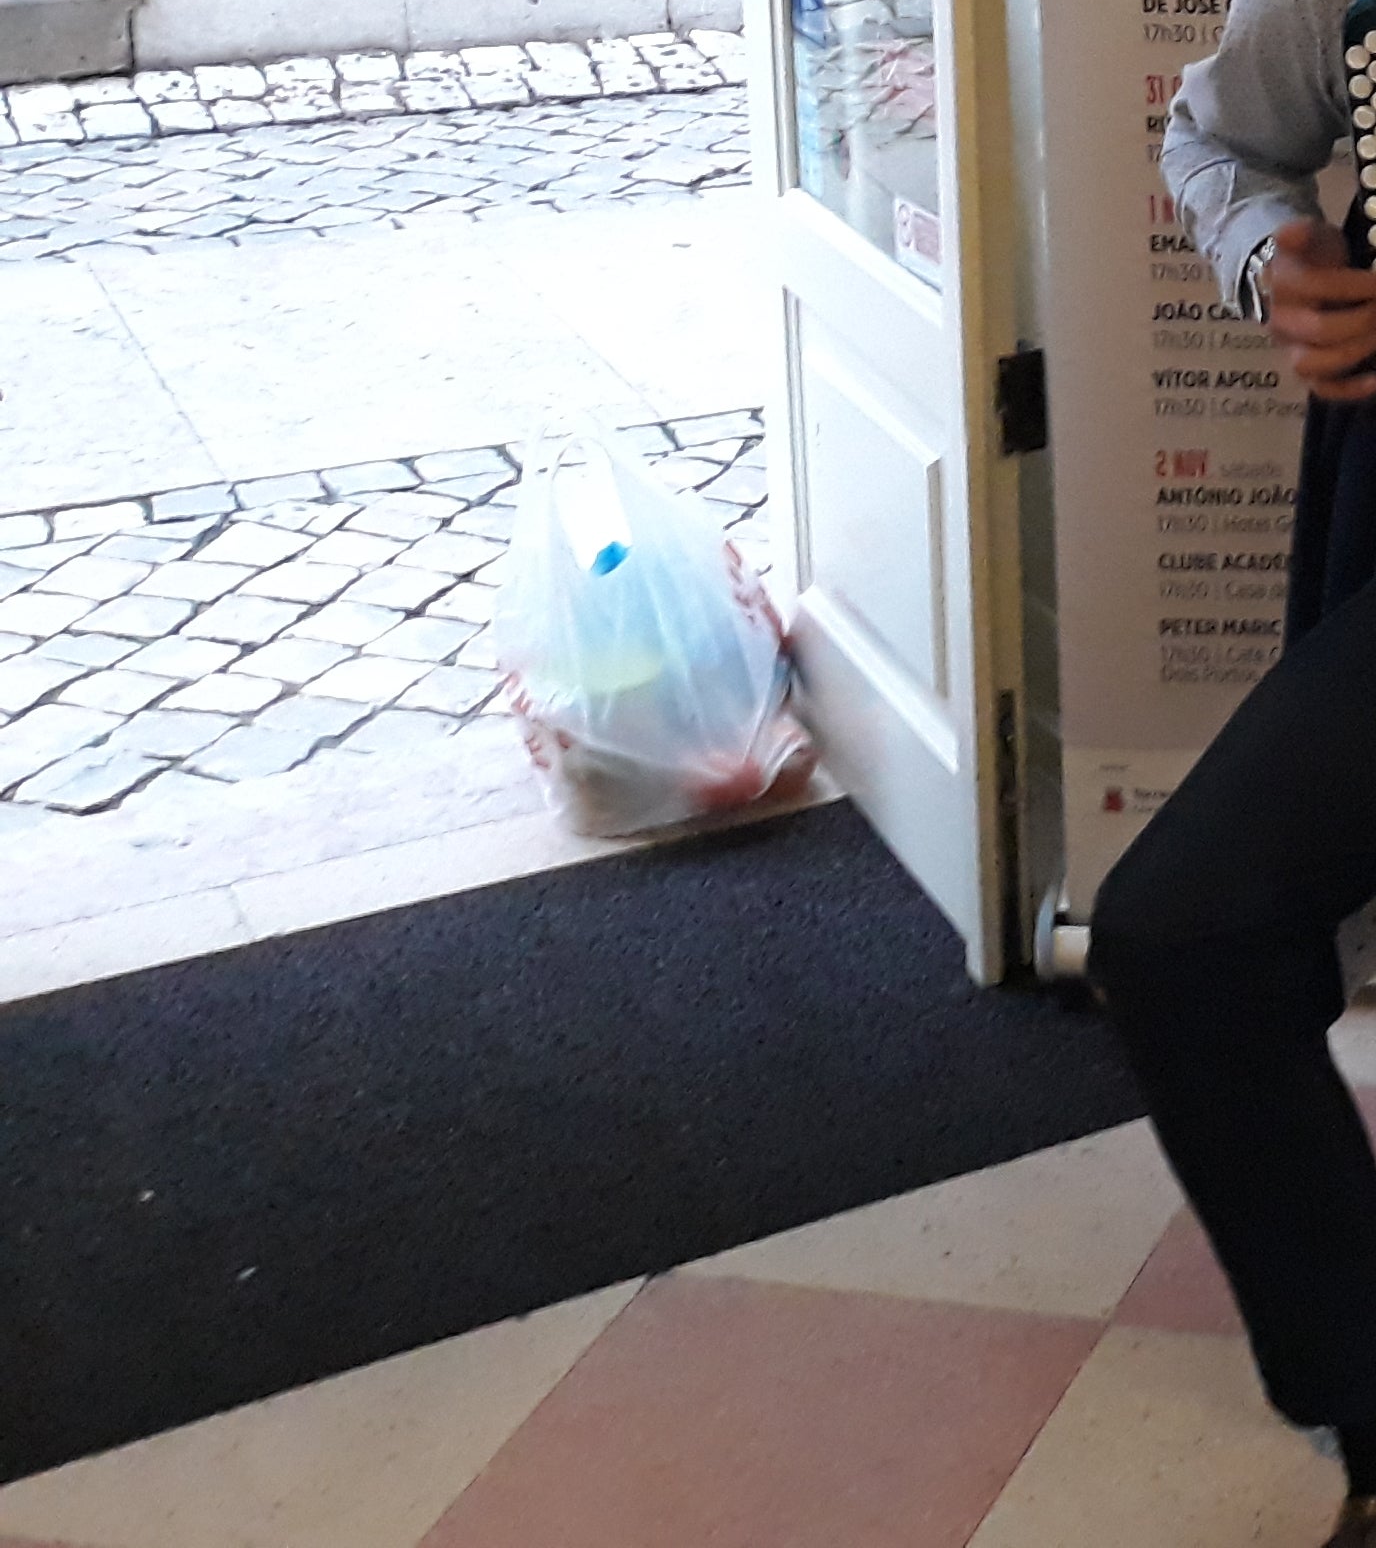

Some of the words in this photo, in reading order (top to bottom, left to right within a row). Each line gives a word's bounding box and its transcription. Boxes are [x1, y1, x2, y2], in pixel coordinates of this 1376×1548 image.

[1152, 369, 1209, 387] VÍTOR
[1215, 370, 1279, 387] APOLO
[1156, 485, 1242, 505] ANTÓNIO
[1159, 619, 1216, 636] PETER
